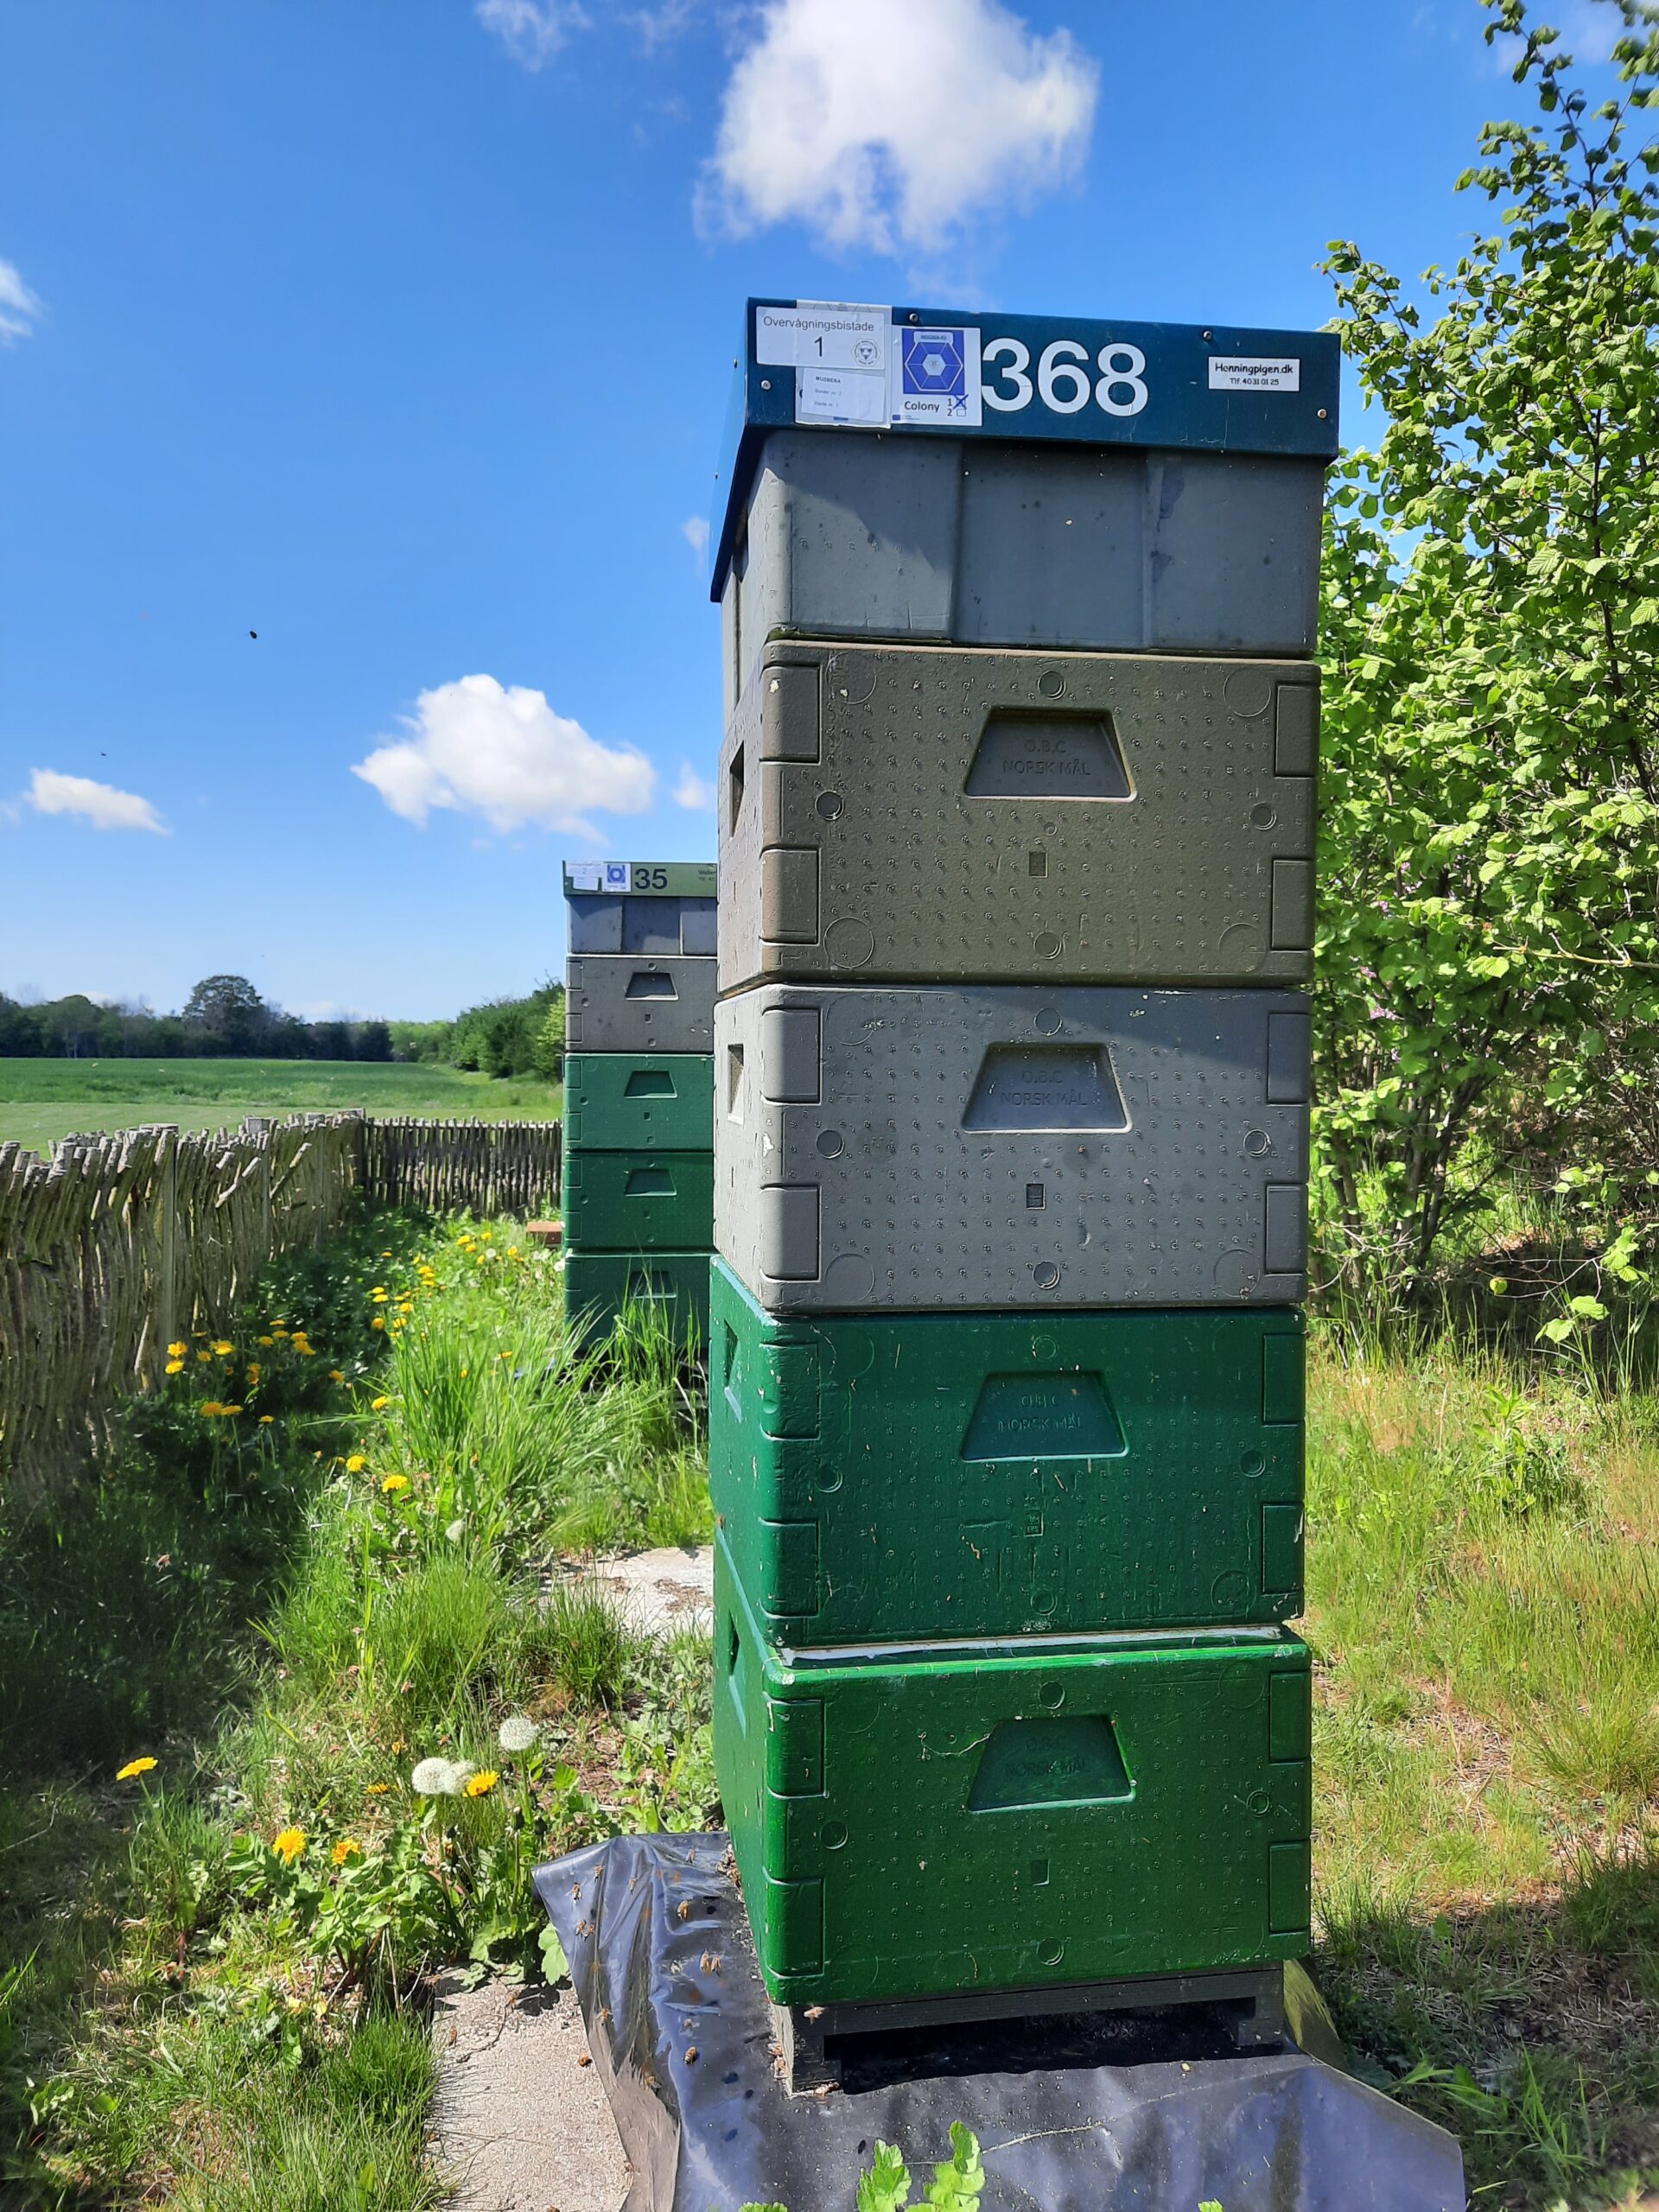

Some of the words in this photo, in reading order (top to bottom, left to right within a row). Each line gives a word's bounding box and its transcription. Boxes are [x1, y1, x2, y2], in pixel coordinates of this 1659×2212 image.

[763, 315, 874, 332] Overvågningsbistade
[814, 335, 823, 357] 1
[981, 338, 1149, 417] 368
[904, 401, 940, 413] Colony
[947, 398, 952, 407] 1
[1003, 760, 1055, 775] NORSK
[1059, 759, 1091, 776] MÅL
[634, 868, 668, 890] 35
[1001, 1091, 1052, 1107] NORSK
[1056, 1089, 1088, 1107] MÅL
